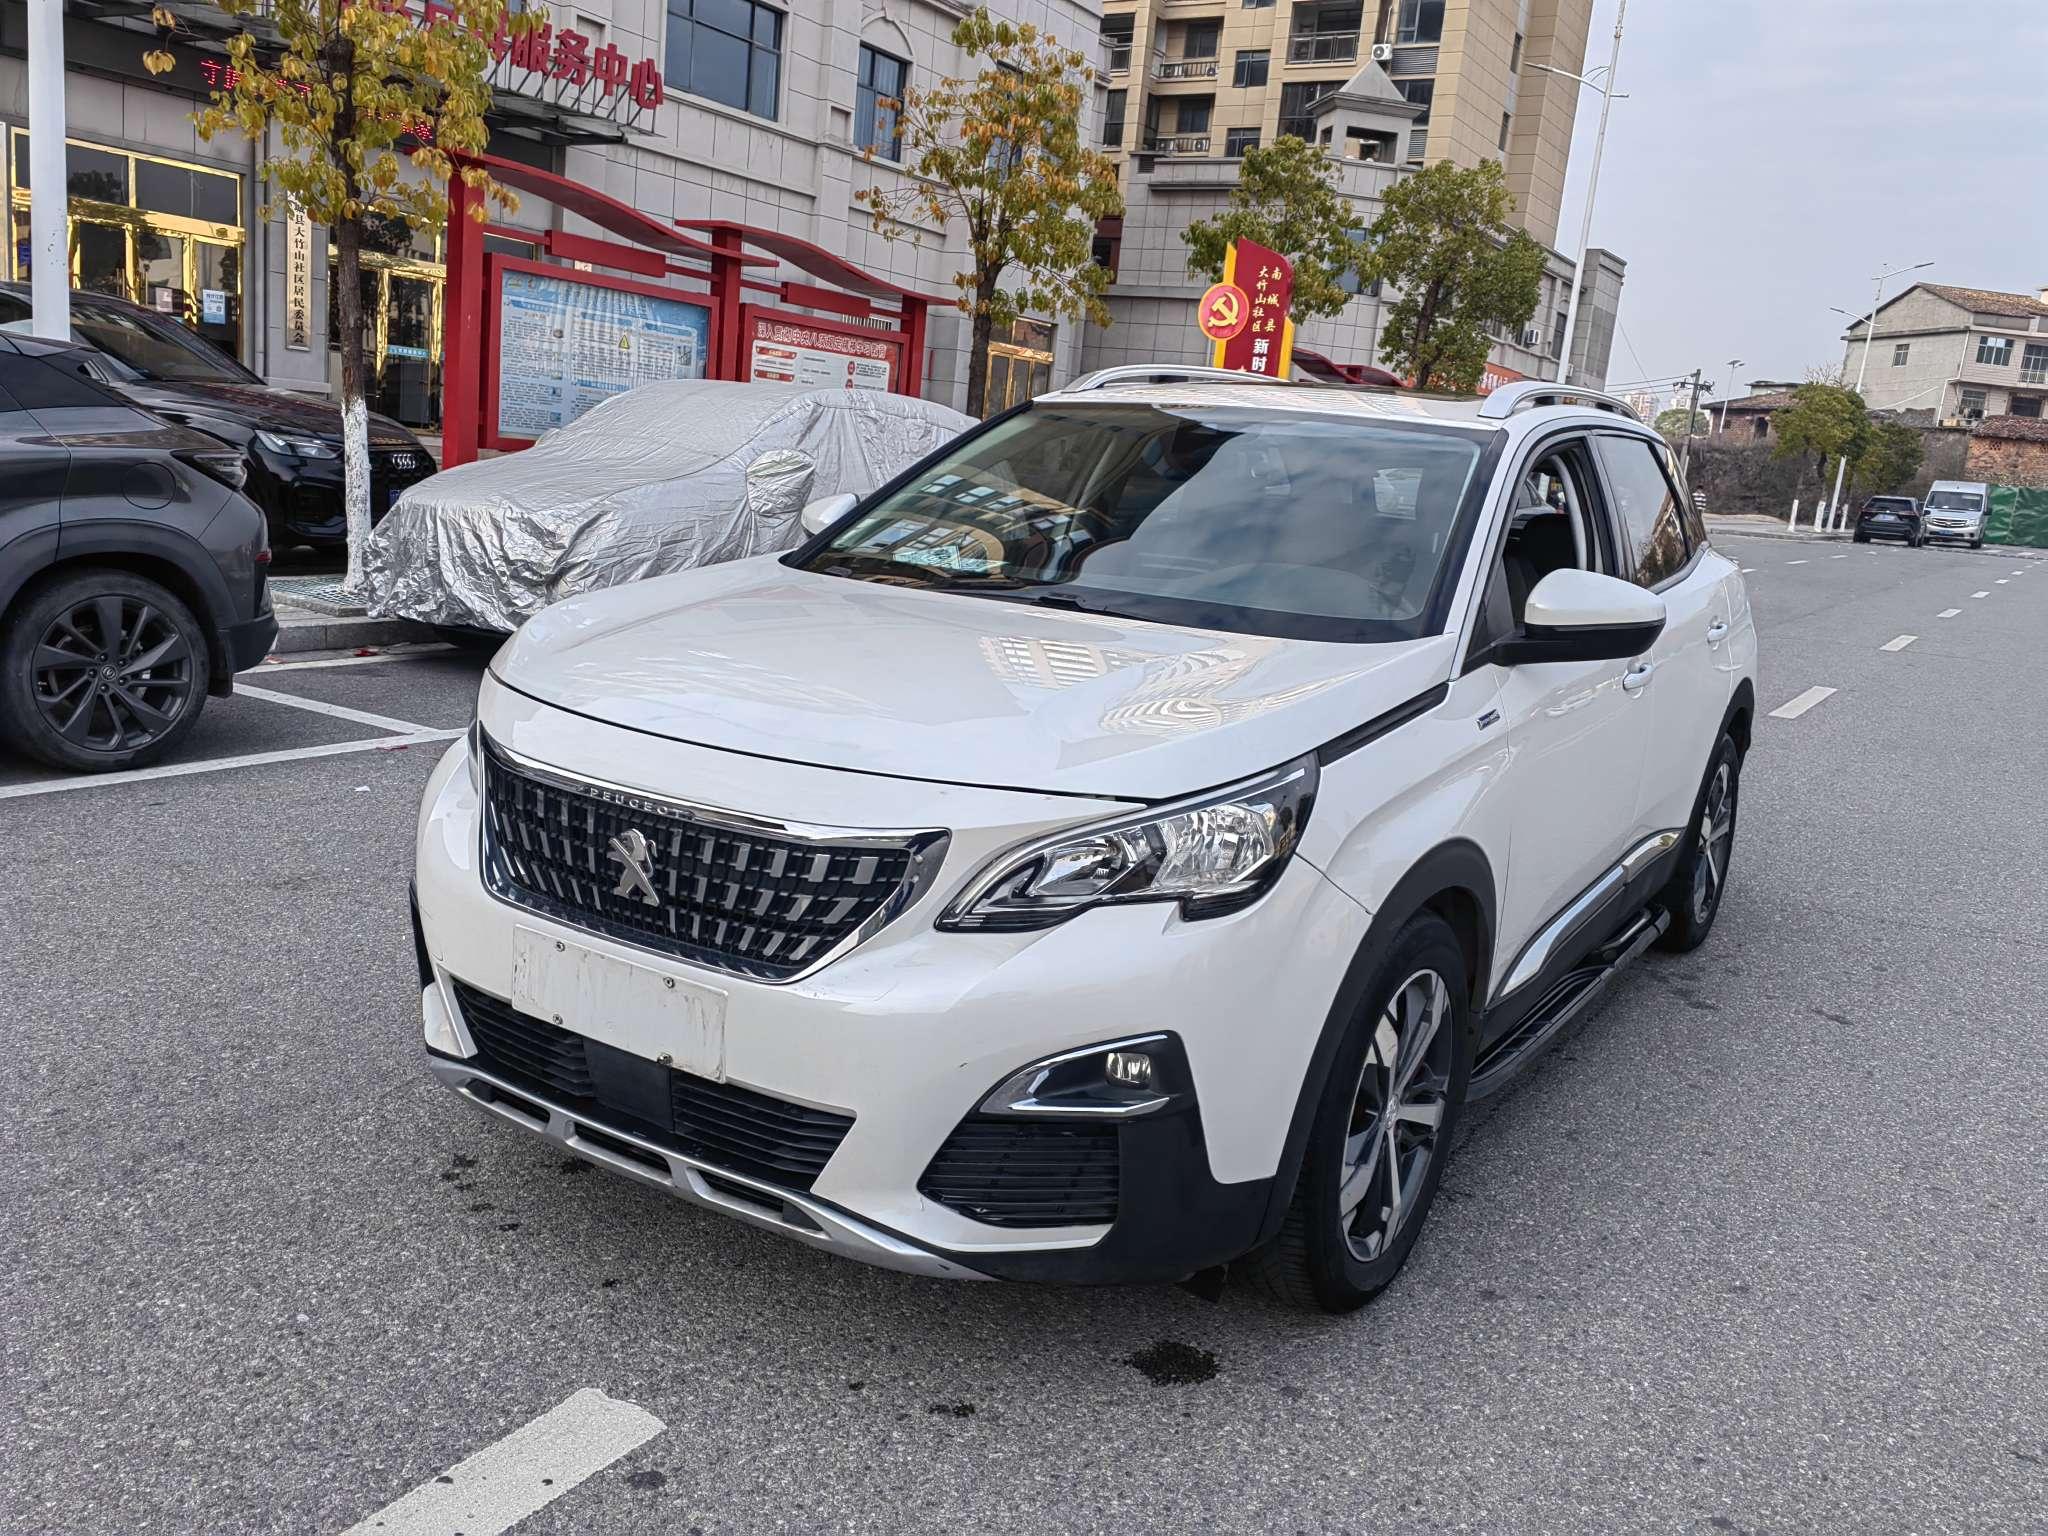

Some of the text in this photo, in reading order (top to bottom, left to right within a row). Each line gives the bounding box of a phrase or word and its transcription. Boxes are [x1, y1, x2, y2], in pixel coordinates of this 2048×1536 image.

[1252, 265, 1269, 332] 大竹山社区
[1264, 266, 1282, 332] 南城县
[1252, 338, 1270, 372] 新时
[590, 787, 684, 819] PEUGEOT
